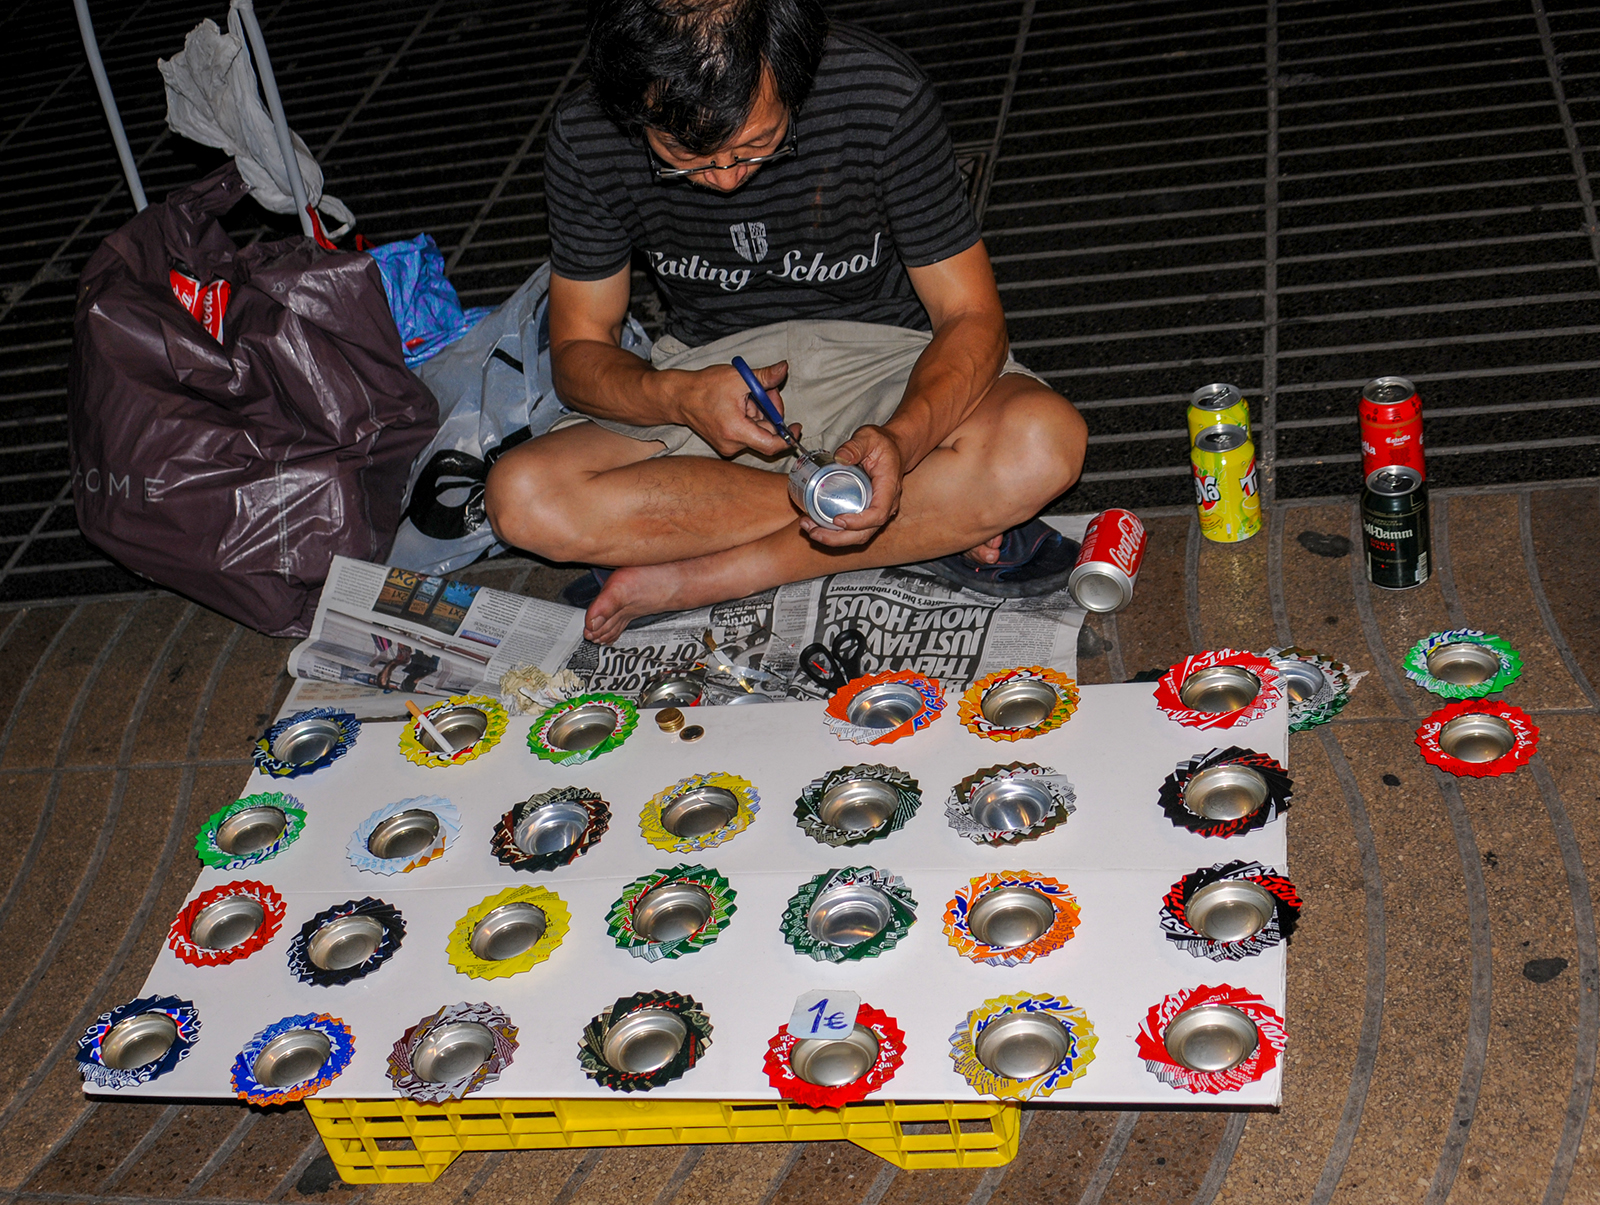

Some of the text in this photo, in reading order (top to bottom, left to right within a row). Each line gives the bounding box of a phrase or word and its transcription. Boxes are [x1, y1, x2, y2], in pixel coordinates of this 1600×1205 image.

[767, 232, 881, 282] School
[1363, 518, 1413, 540] oll-Damm
[829, 585, 858, 593] report
[859, 585, 891, 594] rubbish
[892, 588, 901, 599] to
[902, 593, 917, 604] bid
[825, 596, 990, 631] MOVE HOUSE
[666, 642, 698, 662] OF
[919, 629, 984, 657] JUST
[595, 654, 640, 677] OUT
[901, 656, 971, 679] THEN
[808, 998, 848, 1033] 1€
